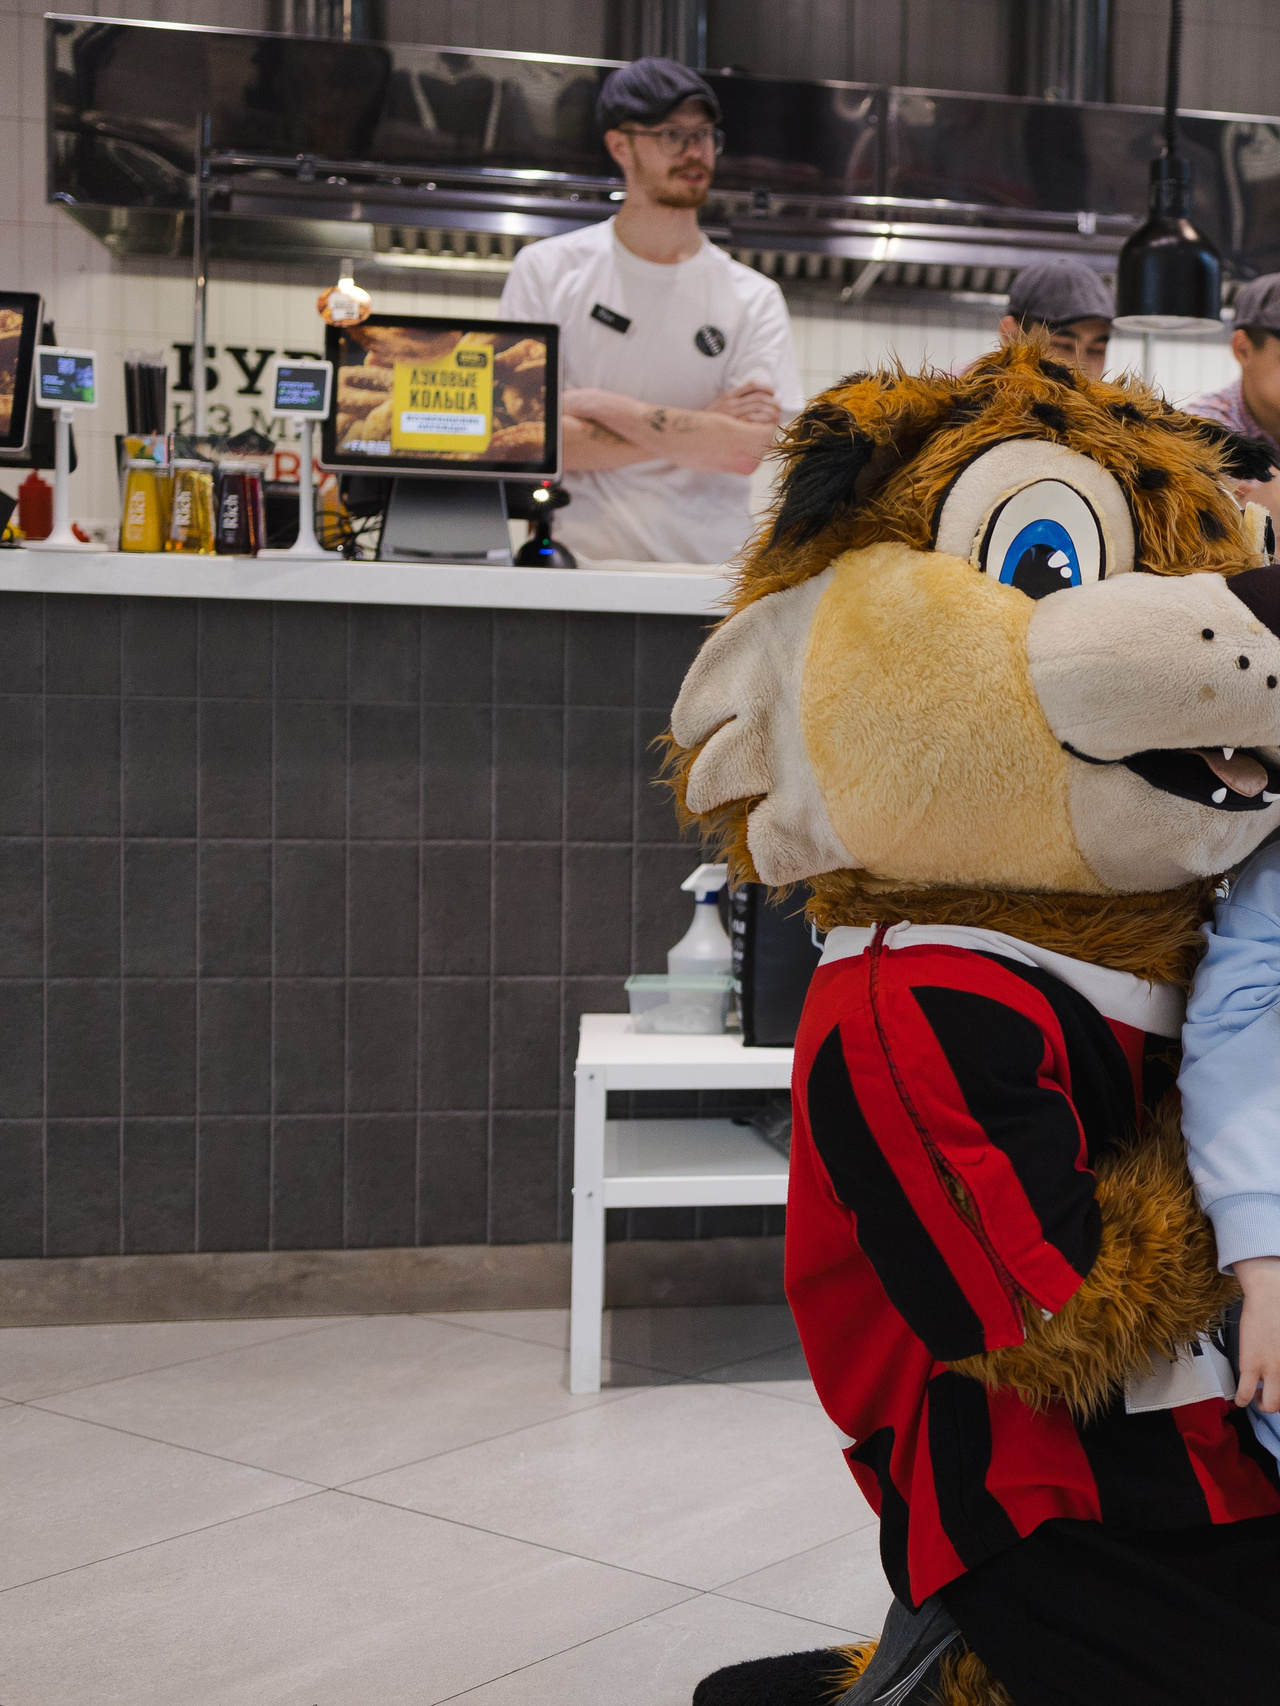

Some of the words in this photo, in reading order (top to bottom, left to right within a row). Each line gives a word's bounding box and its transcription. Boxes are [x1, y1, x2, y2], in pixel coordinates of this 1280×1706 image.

[409, 388, 478, 411] КОЛЬЦА
[129, 491, 146, 525] Rich
[175, 491, 192, 526] Rich
[222, 494, 239, 529] Rich
